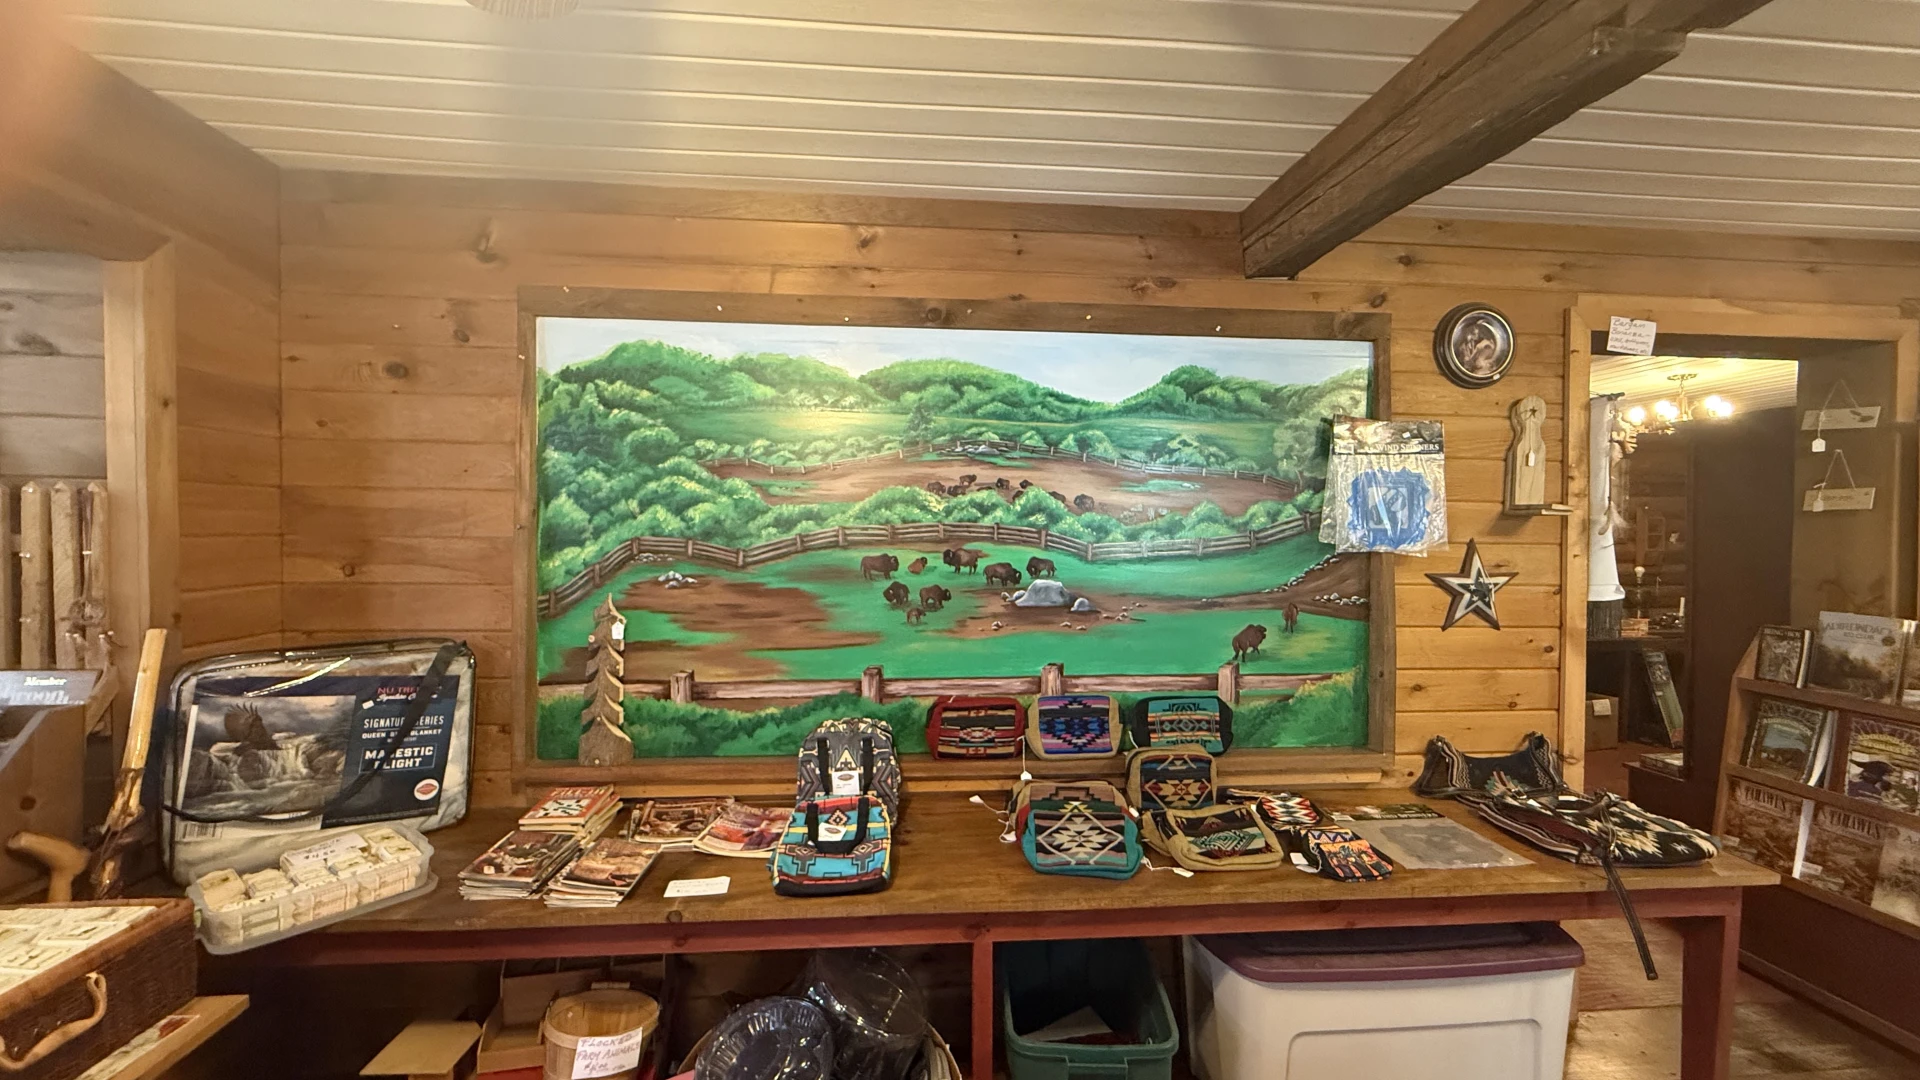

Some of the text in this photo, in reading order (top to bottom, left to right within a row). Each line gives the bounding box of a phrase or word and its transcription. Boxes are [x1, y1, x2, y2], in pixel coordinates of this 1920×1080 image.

[1376, 443, 1440, 451] WIND SPINNERS
[363, 716, 405, 729] SIGNATU
[361, 731, 386, 739] QUEEN
